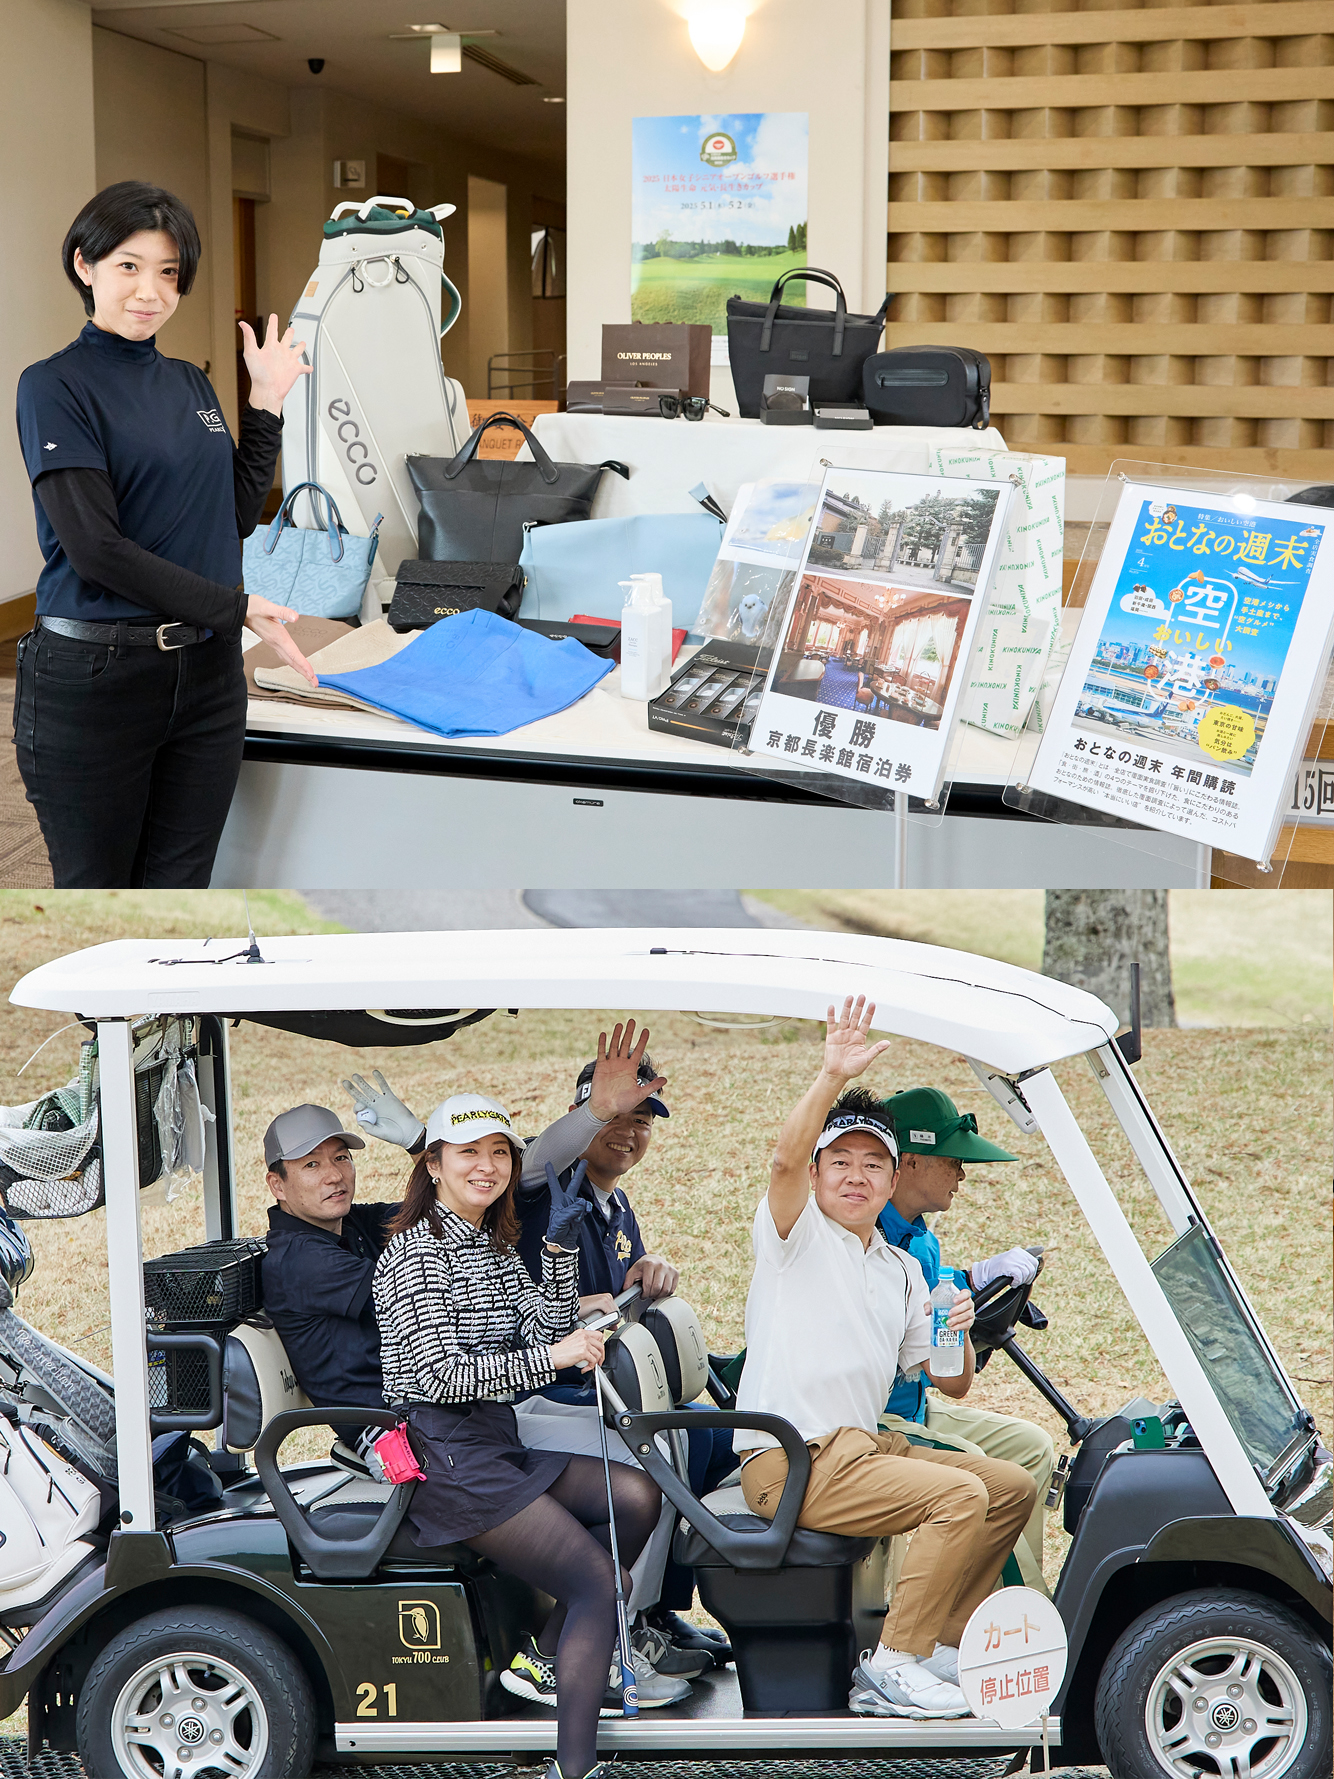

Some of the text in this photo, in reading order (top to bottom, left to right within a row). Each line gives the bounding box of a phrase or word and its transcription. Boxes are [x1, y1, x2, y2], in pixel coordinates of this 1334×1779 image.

[617, 352, 672, 361] OLIVER PEOPLES
[328, 398, 377, 486] ecco
[1140, 517, 1310, 570] おとなの週末
[434, 607, 460, 615] ecco
[1178, 584, 1229, 629] 空
[1243, 597, 1290, 613] 空港メシから
[988, 628, 998, 671] KINOKUNIYA
[1002, 646, 1042, 655] KINOKUNIYA
[1153, 624, 1233, 653] おいしい
[1235, 625, 1259, 637] 大調査
[1012, 664, 1022, 710] KINOKUNIYA
[1157, 650, 1207, 697] 港
[812, 709, 877, 749] 優勝
[1212, 719, 1244, 732] 東京の甘味
[766, 730, 913, 784] 京都長楽館宿泊券
[1074, 737, 1237, 796] おとなの週末 年間購読
[16, 1329, 76, 1392] Resurrection
[984, 1613, 1041, 1652] カート
[392, 1651, 450, 1664] TOKYU 700 CLUB
[356, 1682, 397, 1717] 21
[980, 1665, 1050, 1706] 停止位置
